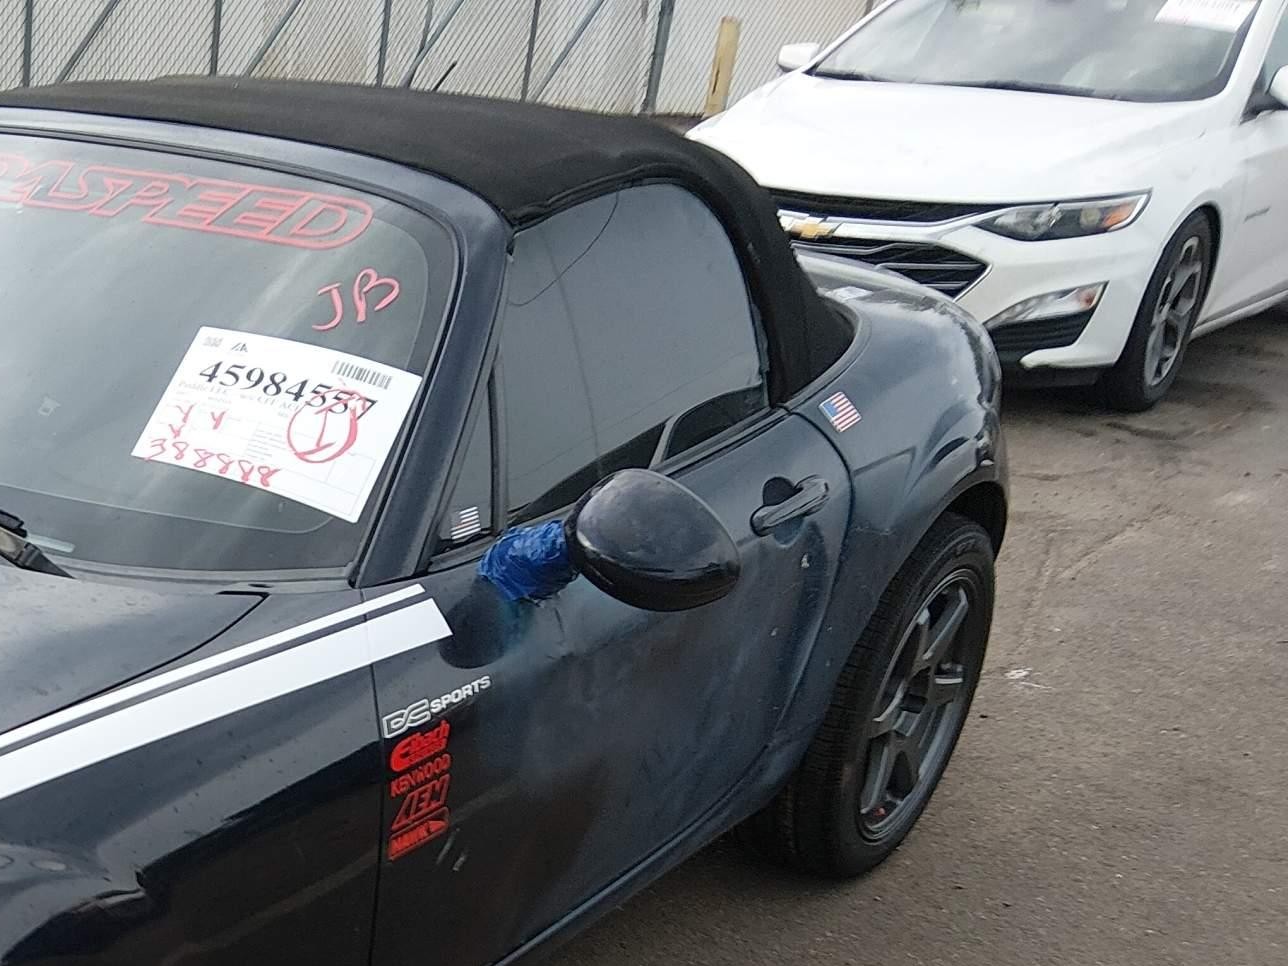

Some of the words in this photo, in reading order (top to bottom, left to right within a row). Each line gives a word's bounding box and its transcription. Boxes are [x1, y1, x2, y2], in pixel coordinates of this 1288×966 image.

[199, 360, 378, 421] 45984557
[430, 675, 492, 713] SPORTS
[390, 753, 451, 797] KENWOOD
